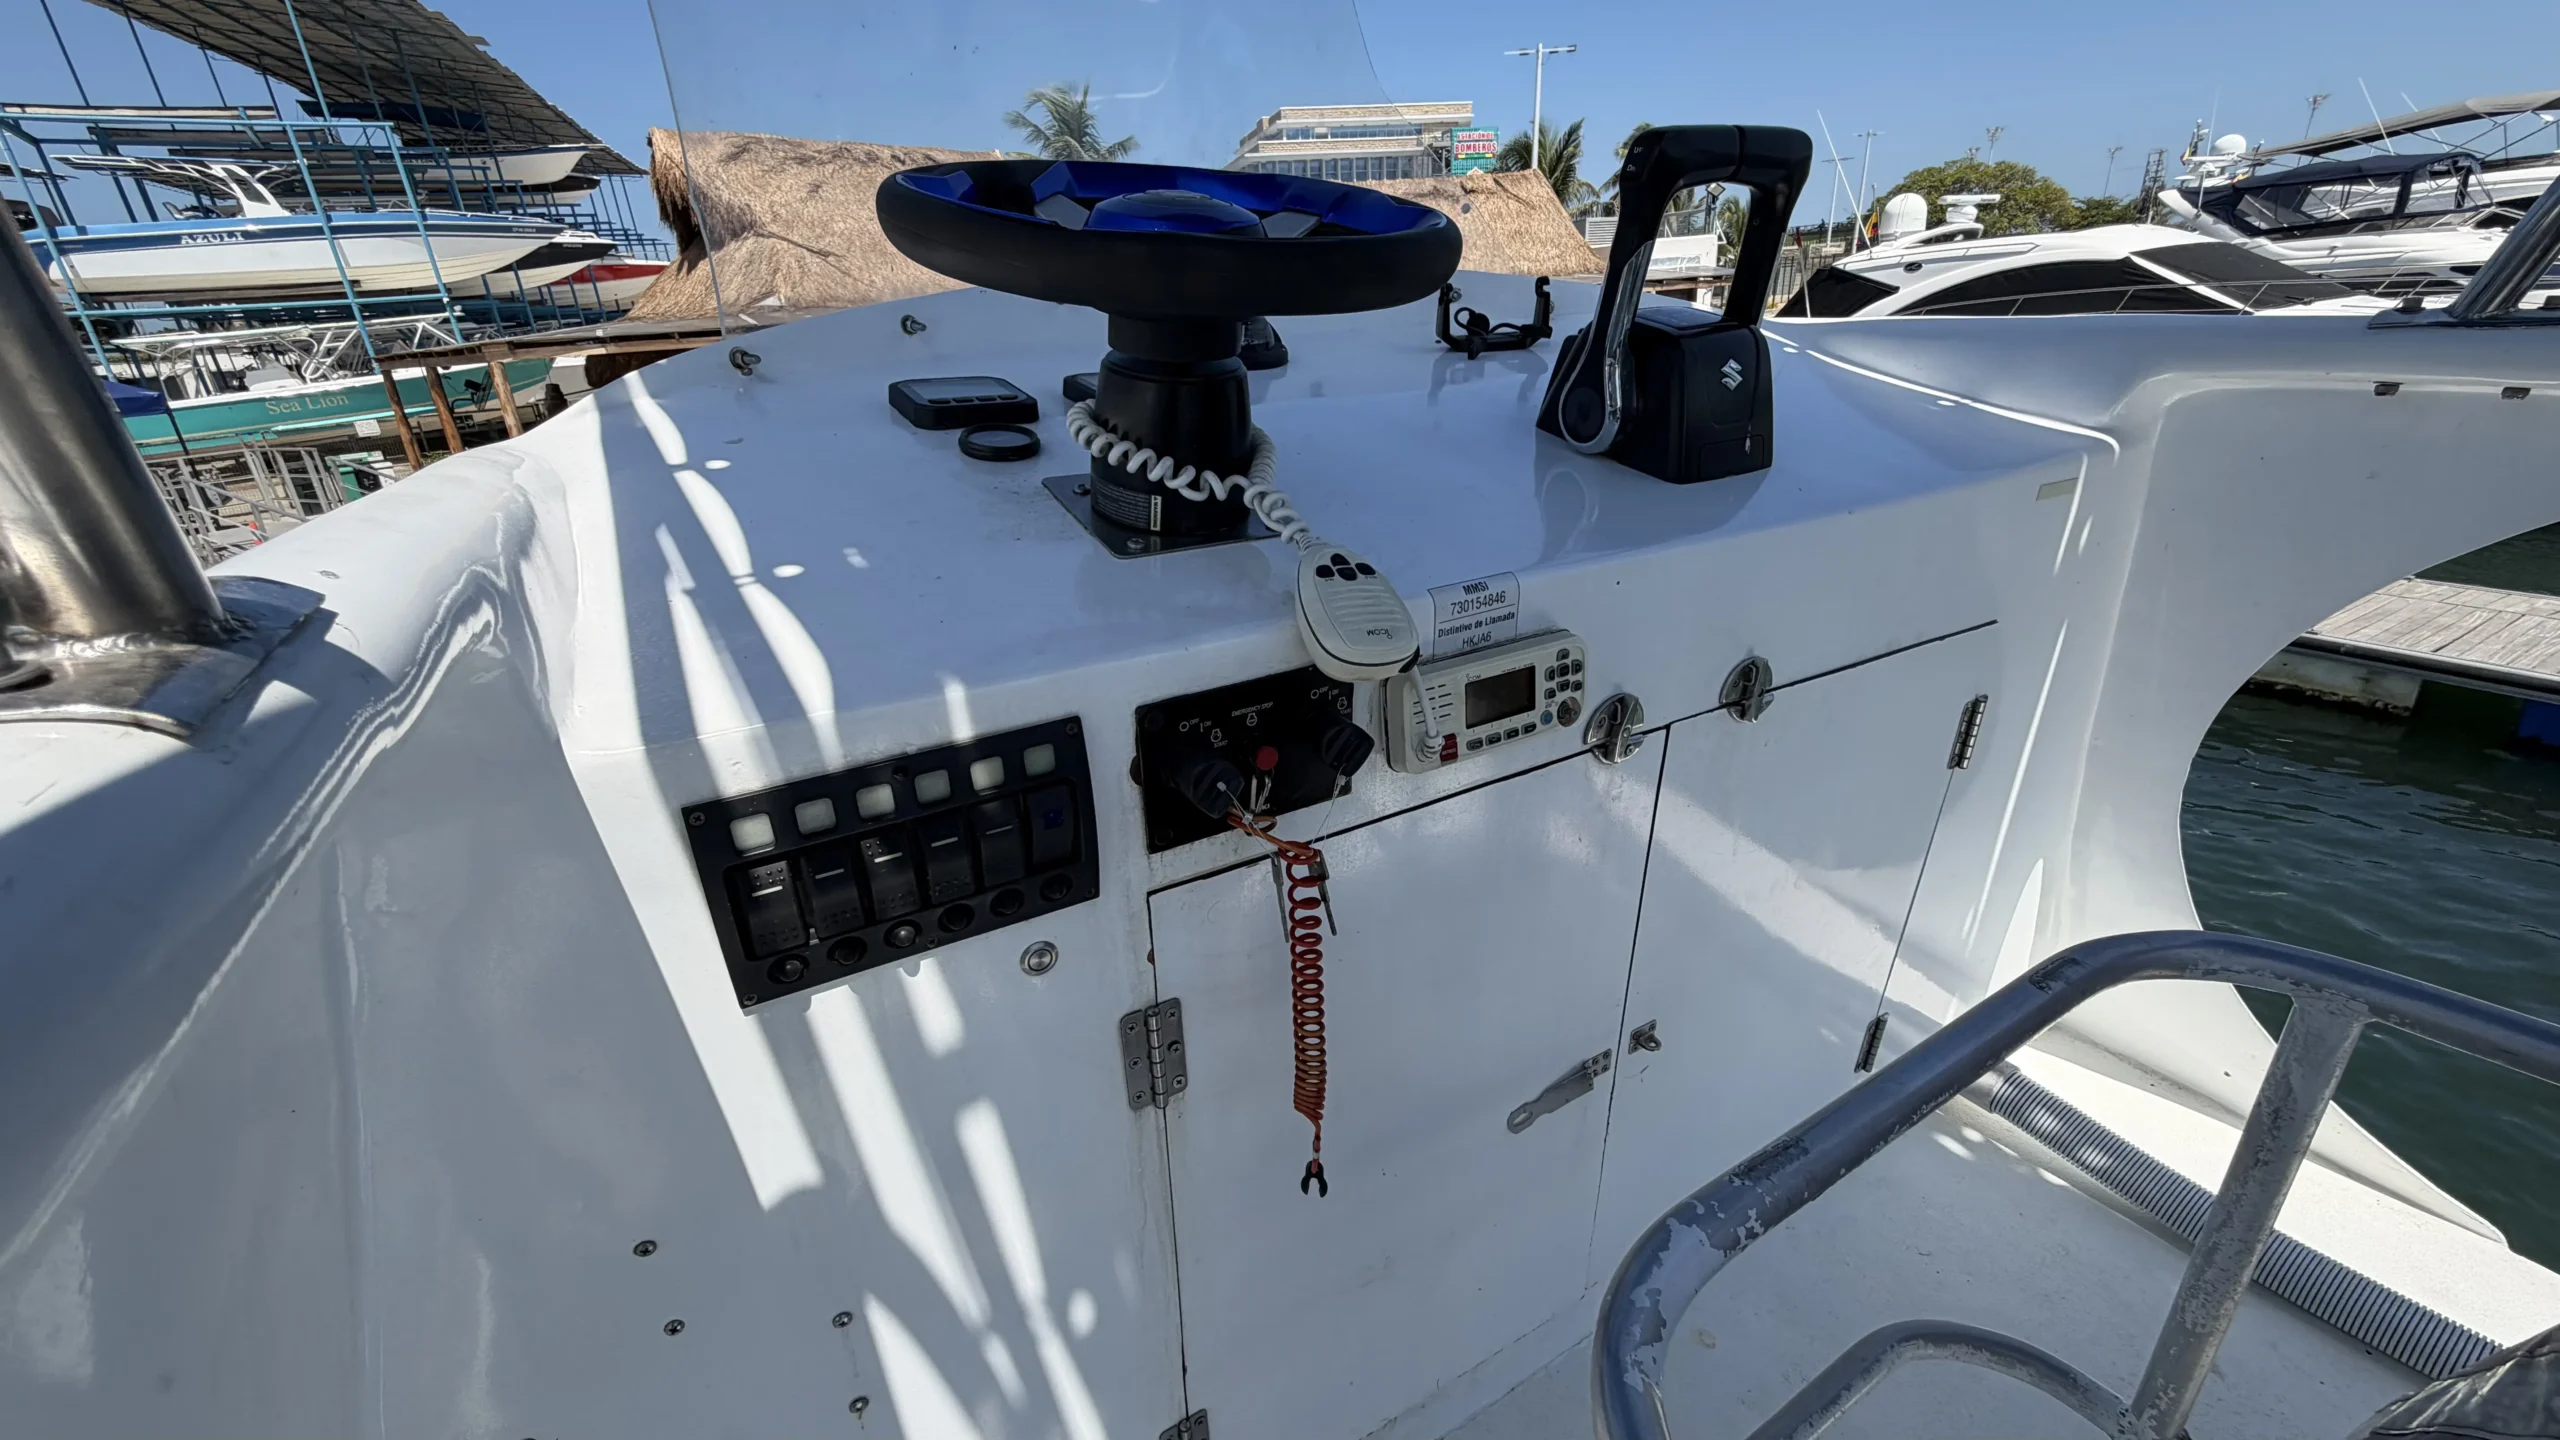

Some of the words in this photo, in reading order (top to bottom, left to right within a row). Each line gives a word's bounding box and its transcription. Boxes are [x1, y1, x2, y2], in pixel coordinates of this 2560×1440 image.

[1455, 142, 1497, 152] BOMBEROS
[180, 231, 245, 245] AZULI
[265, 400, 302, 415] Sea
[304, 395, 350, 410] Lion
[1462, 581, 1490, 596] MMSI
[1450, 590, 1506, 616] 730154846
[1437, 623, 1473, 638] Distintivo
[1474, 619, 1484, 629] de
[1485, 611, 1515, 626] Llamada
[1462, 631, 1492, 649] HKJA6
[1231, 704, 1261, 717] EMERGENCY
[1261, 701, 1274, 709] STOP
[1189, 717, 1200, 725] OFF
